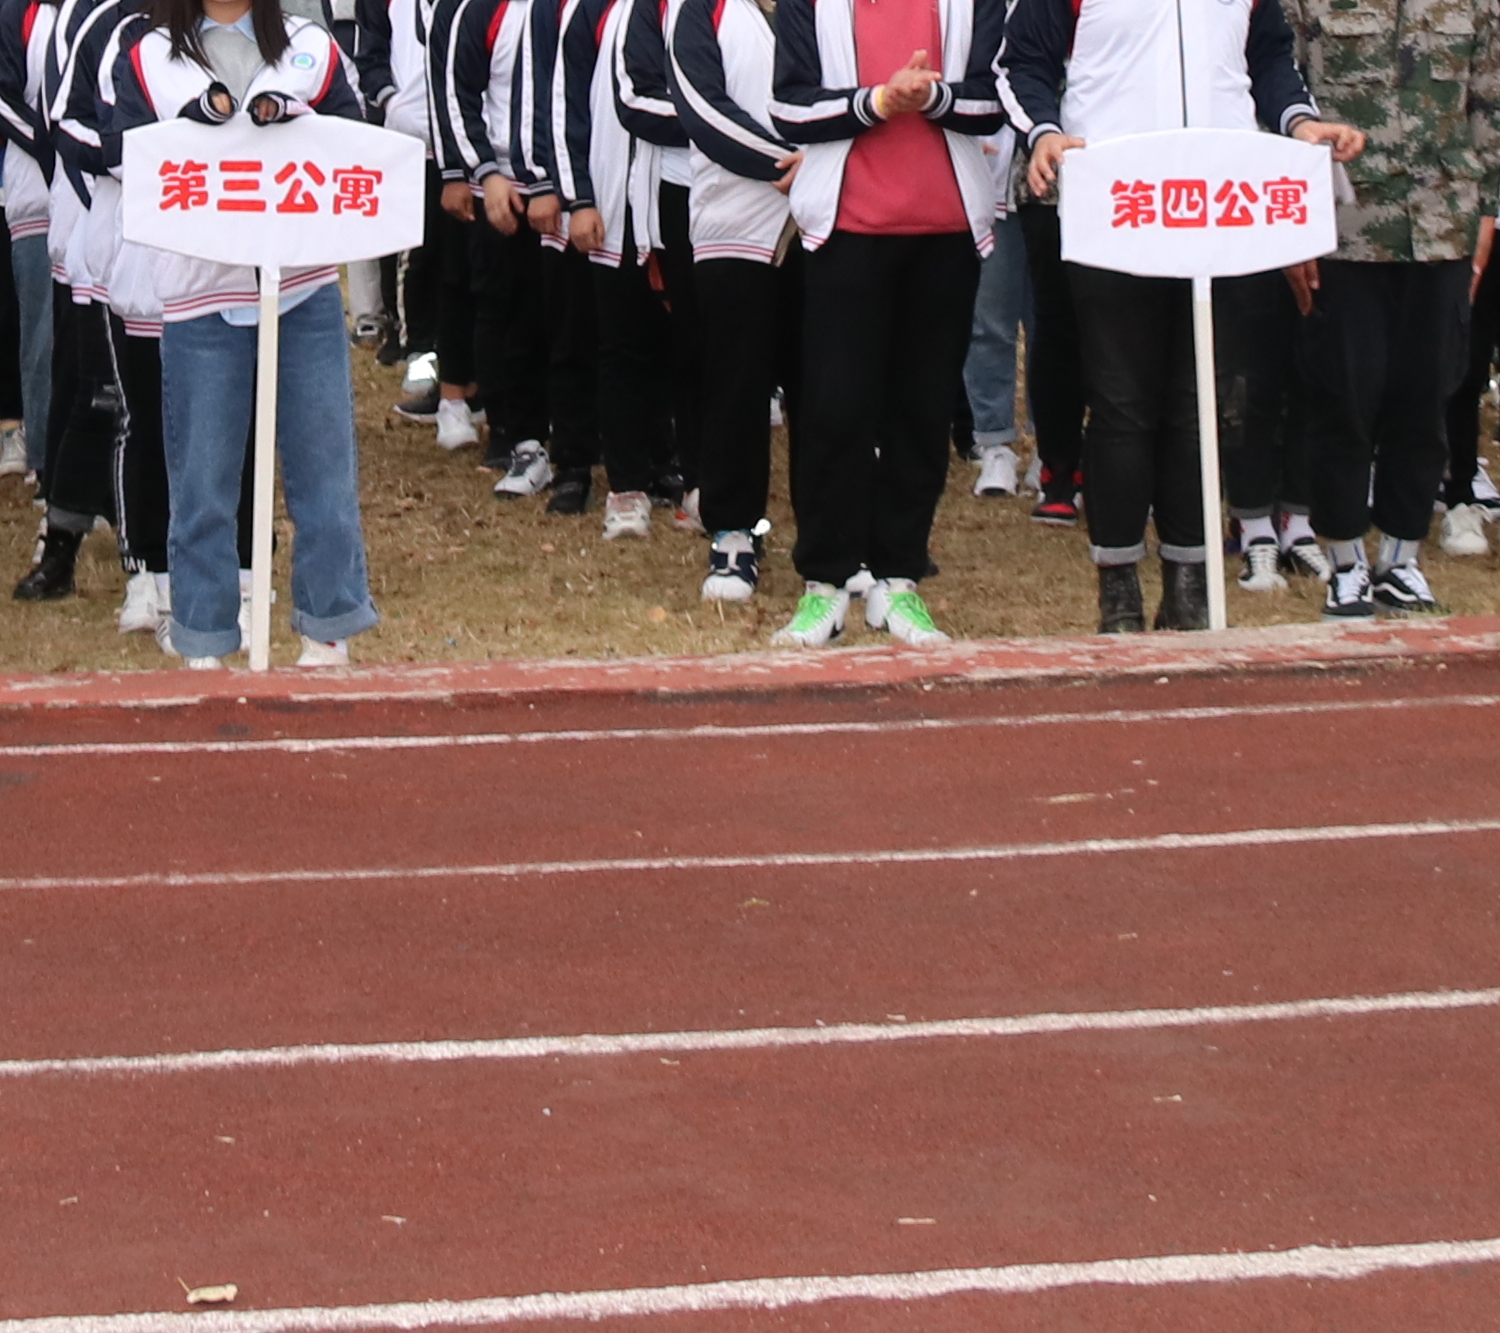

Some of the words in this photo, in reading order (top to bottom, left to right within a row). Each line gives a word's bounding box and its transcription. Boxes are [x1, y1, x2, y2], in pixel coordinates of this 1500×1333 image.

[158, 159, 385, 218] 第三公寓
[1110, 175, 1310, 229] 第四公寓
